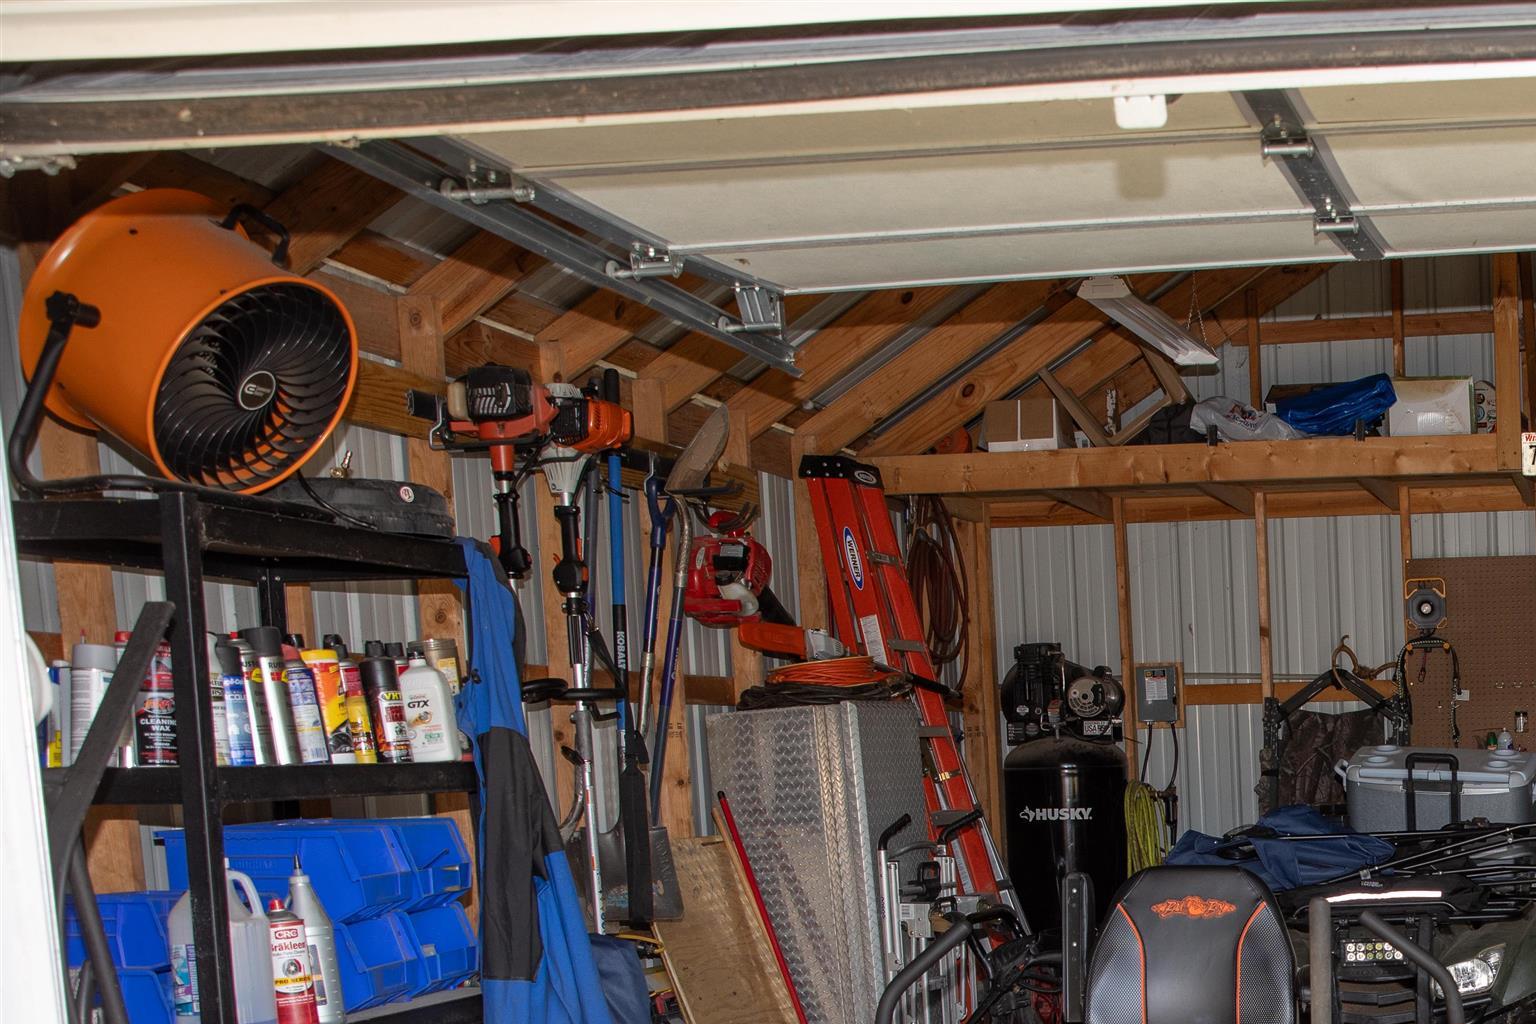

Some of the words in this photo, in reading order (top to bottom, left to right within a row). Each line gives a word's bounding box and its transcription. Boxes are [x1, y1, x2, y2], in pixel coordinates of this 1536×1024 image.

[847, 539, 860, 578] WERNER
[616, 631, 626, 669] KOBALT
[407, 699, 430, 708] GTX
[1036, 807, 1091, 820] HUSKY
[275, 929, 299, 940] CRC
